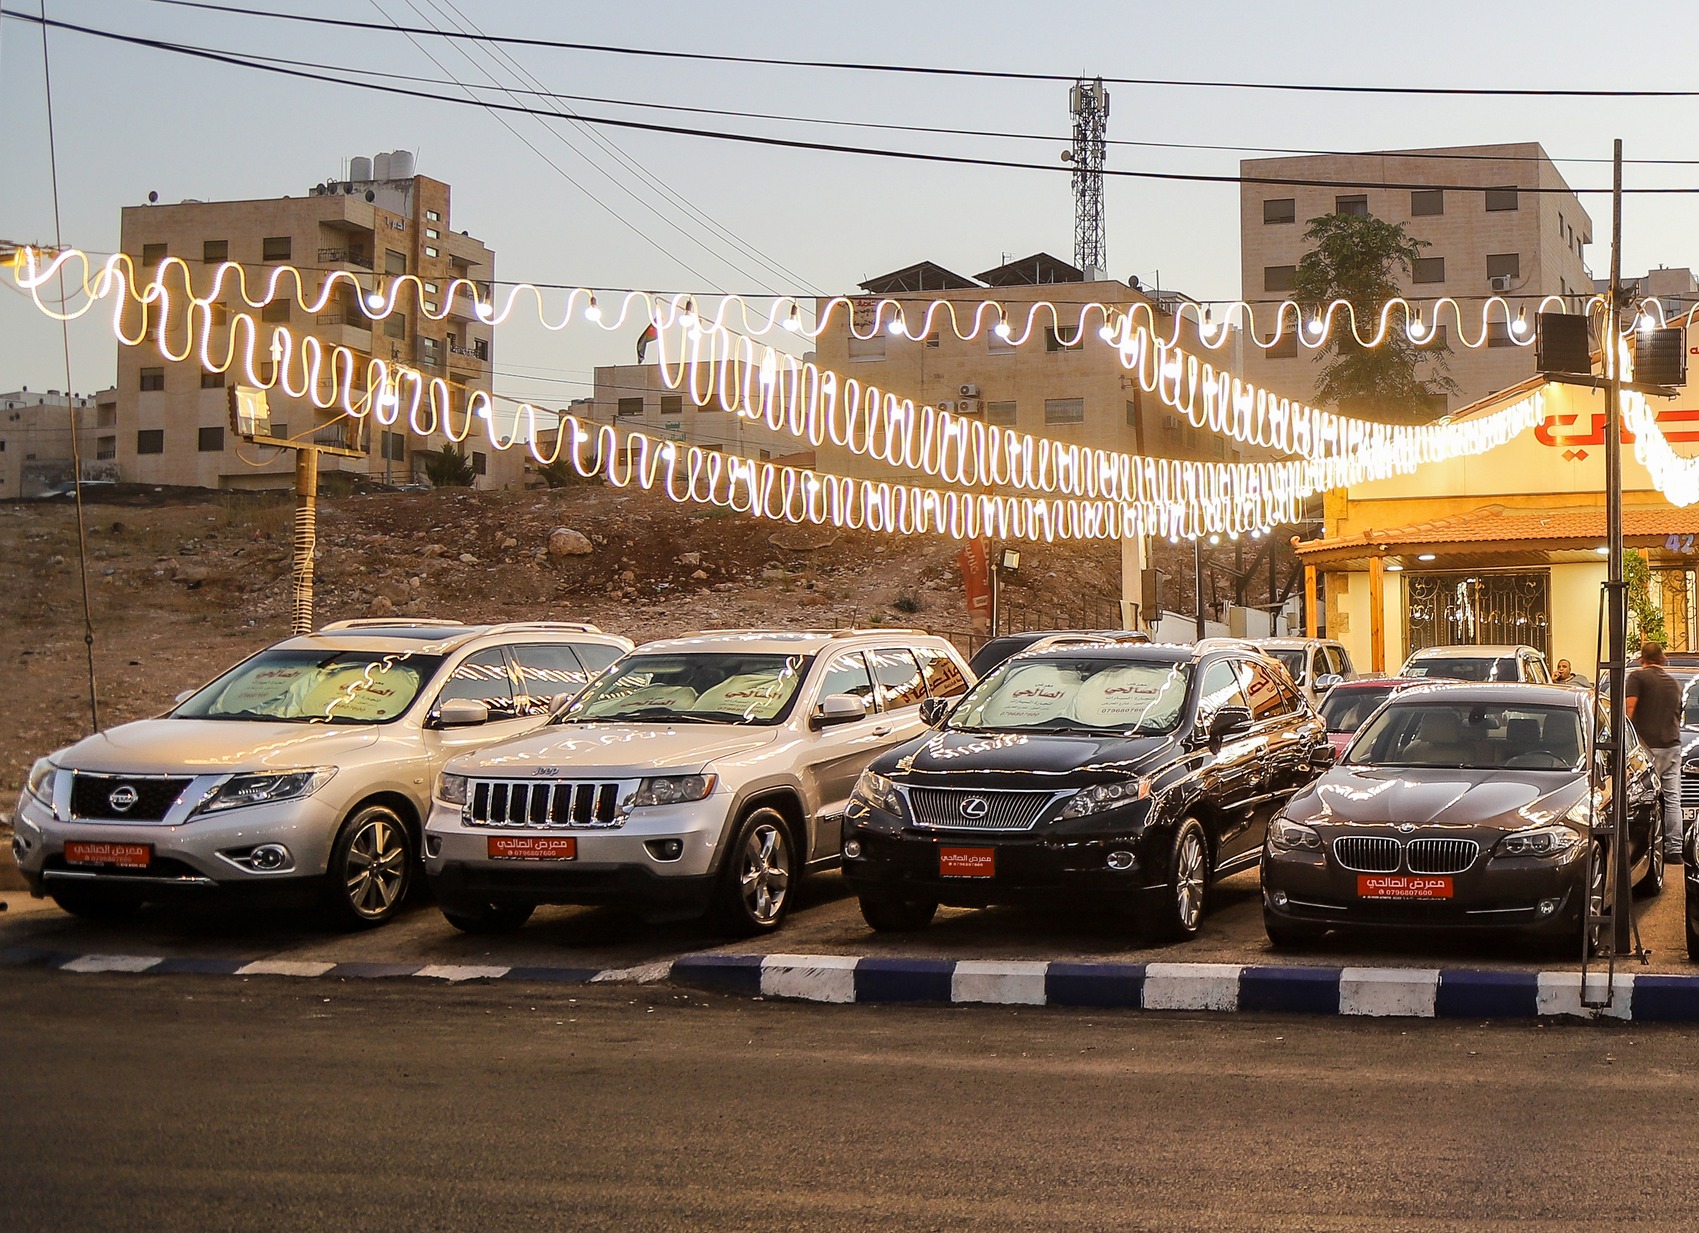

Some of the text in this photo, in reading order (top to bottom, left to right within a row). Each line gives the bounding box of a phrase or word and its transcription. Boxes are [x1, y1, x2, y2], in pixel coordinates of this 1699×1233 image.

[532, 767, 560, 776] Jeep
[497, 838, 568, 850] معرض الصالحي
[1366, 877, 1445, 890] معرض الصالحي
